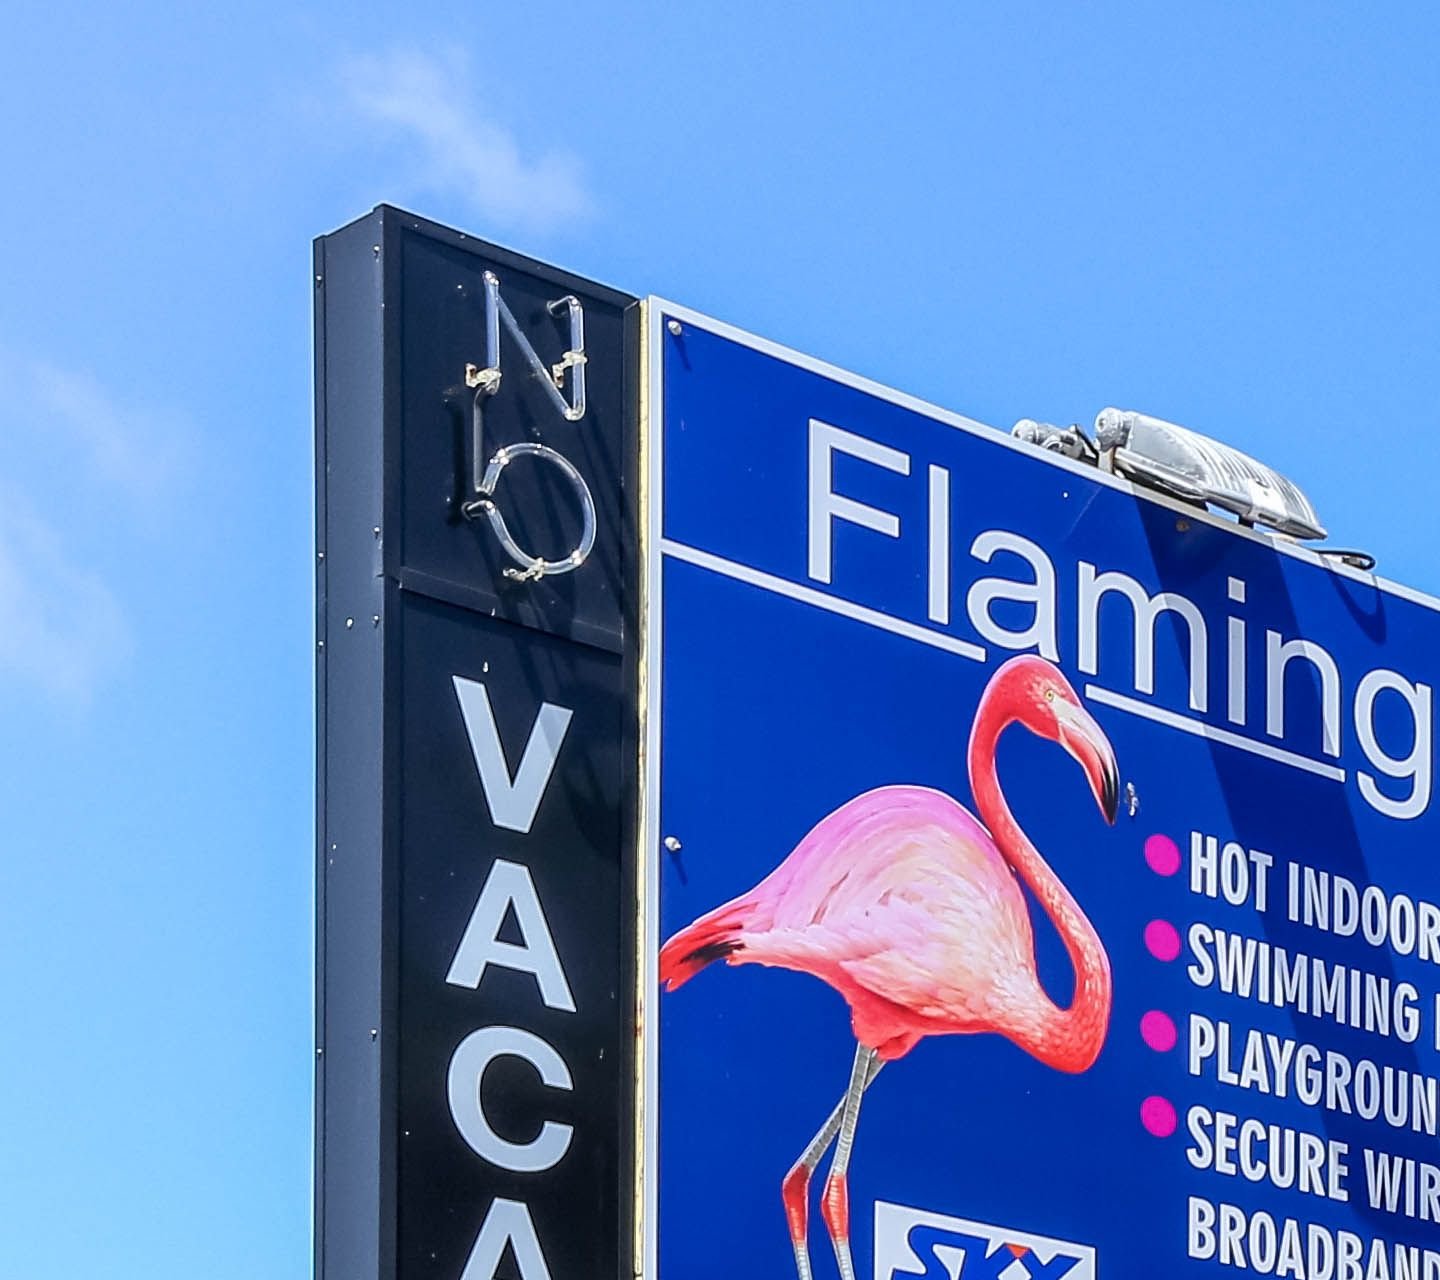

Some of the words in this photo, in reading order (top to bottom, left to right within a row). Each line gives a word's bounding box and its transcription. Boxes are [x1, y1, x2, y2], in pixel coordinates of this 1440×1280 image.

[1190, 830, 1273, 912] HOT
[1187, 922, 1420, 1043] SWIMMING
[1186, 1104, 1349, 1202] SECURE
